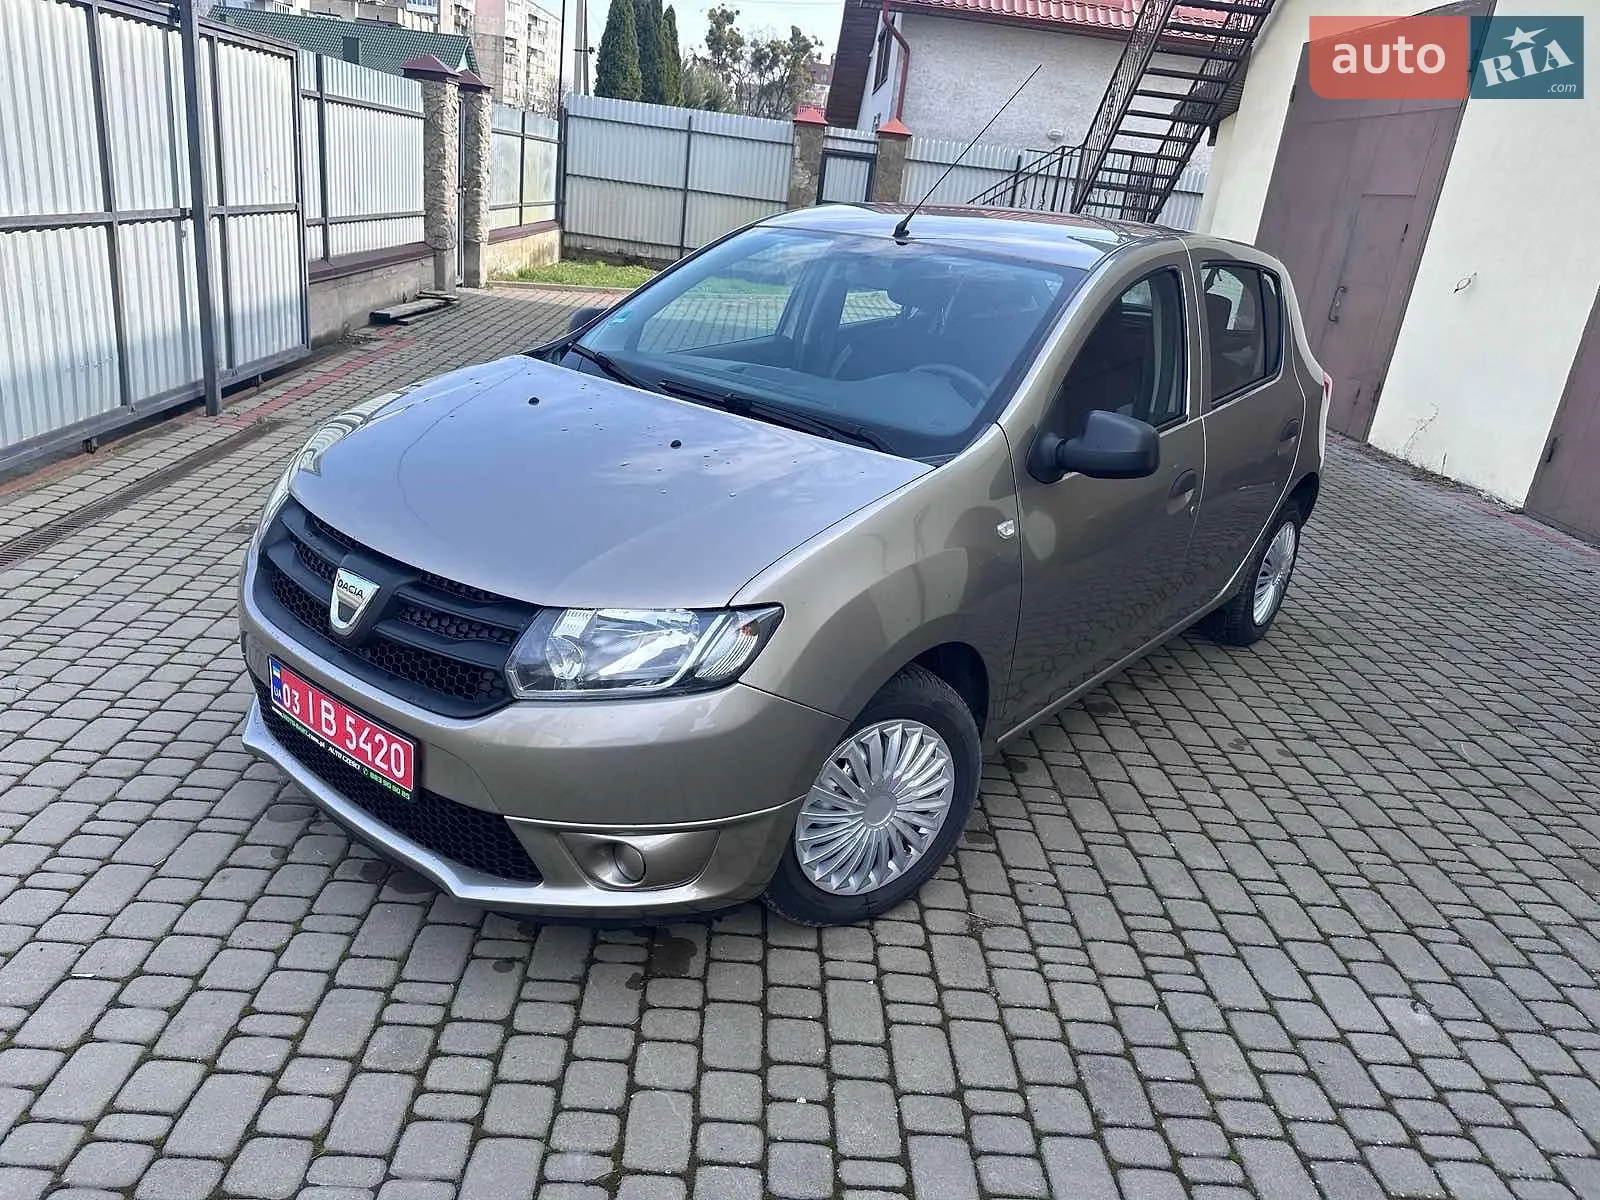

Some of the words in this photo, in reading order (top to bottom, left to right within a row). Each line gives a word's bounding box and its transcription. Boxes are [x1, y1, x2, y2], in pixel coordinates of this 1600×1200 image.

[337, 579, 364, 598] DACIA
[282, 683, 300, 715] 03
[345, 714, 405, 779] 5420
